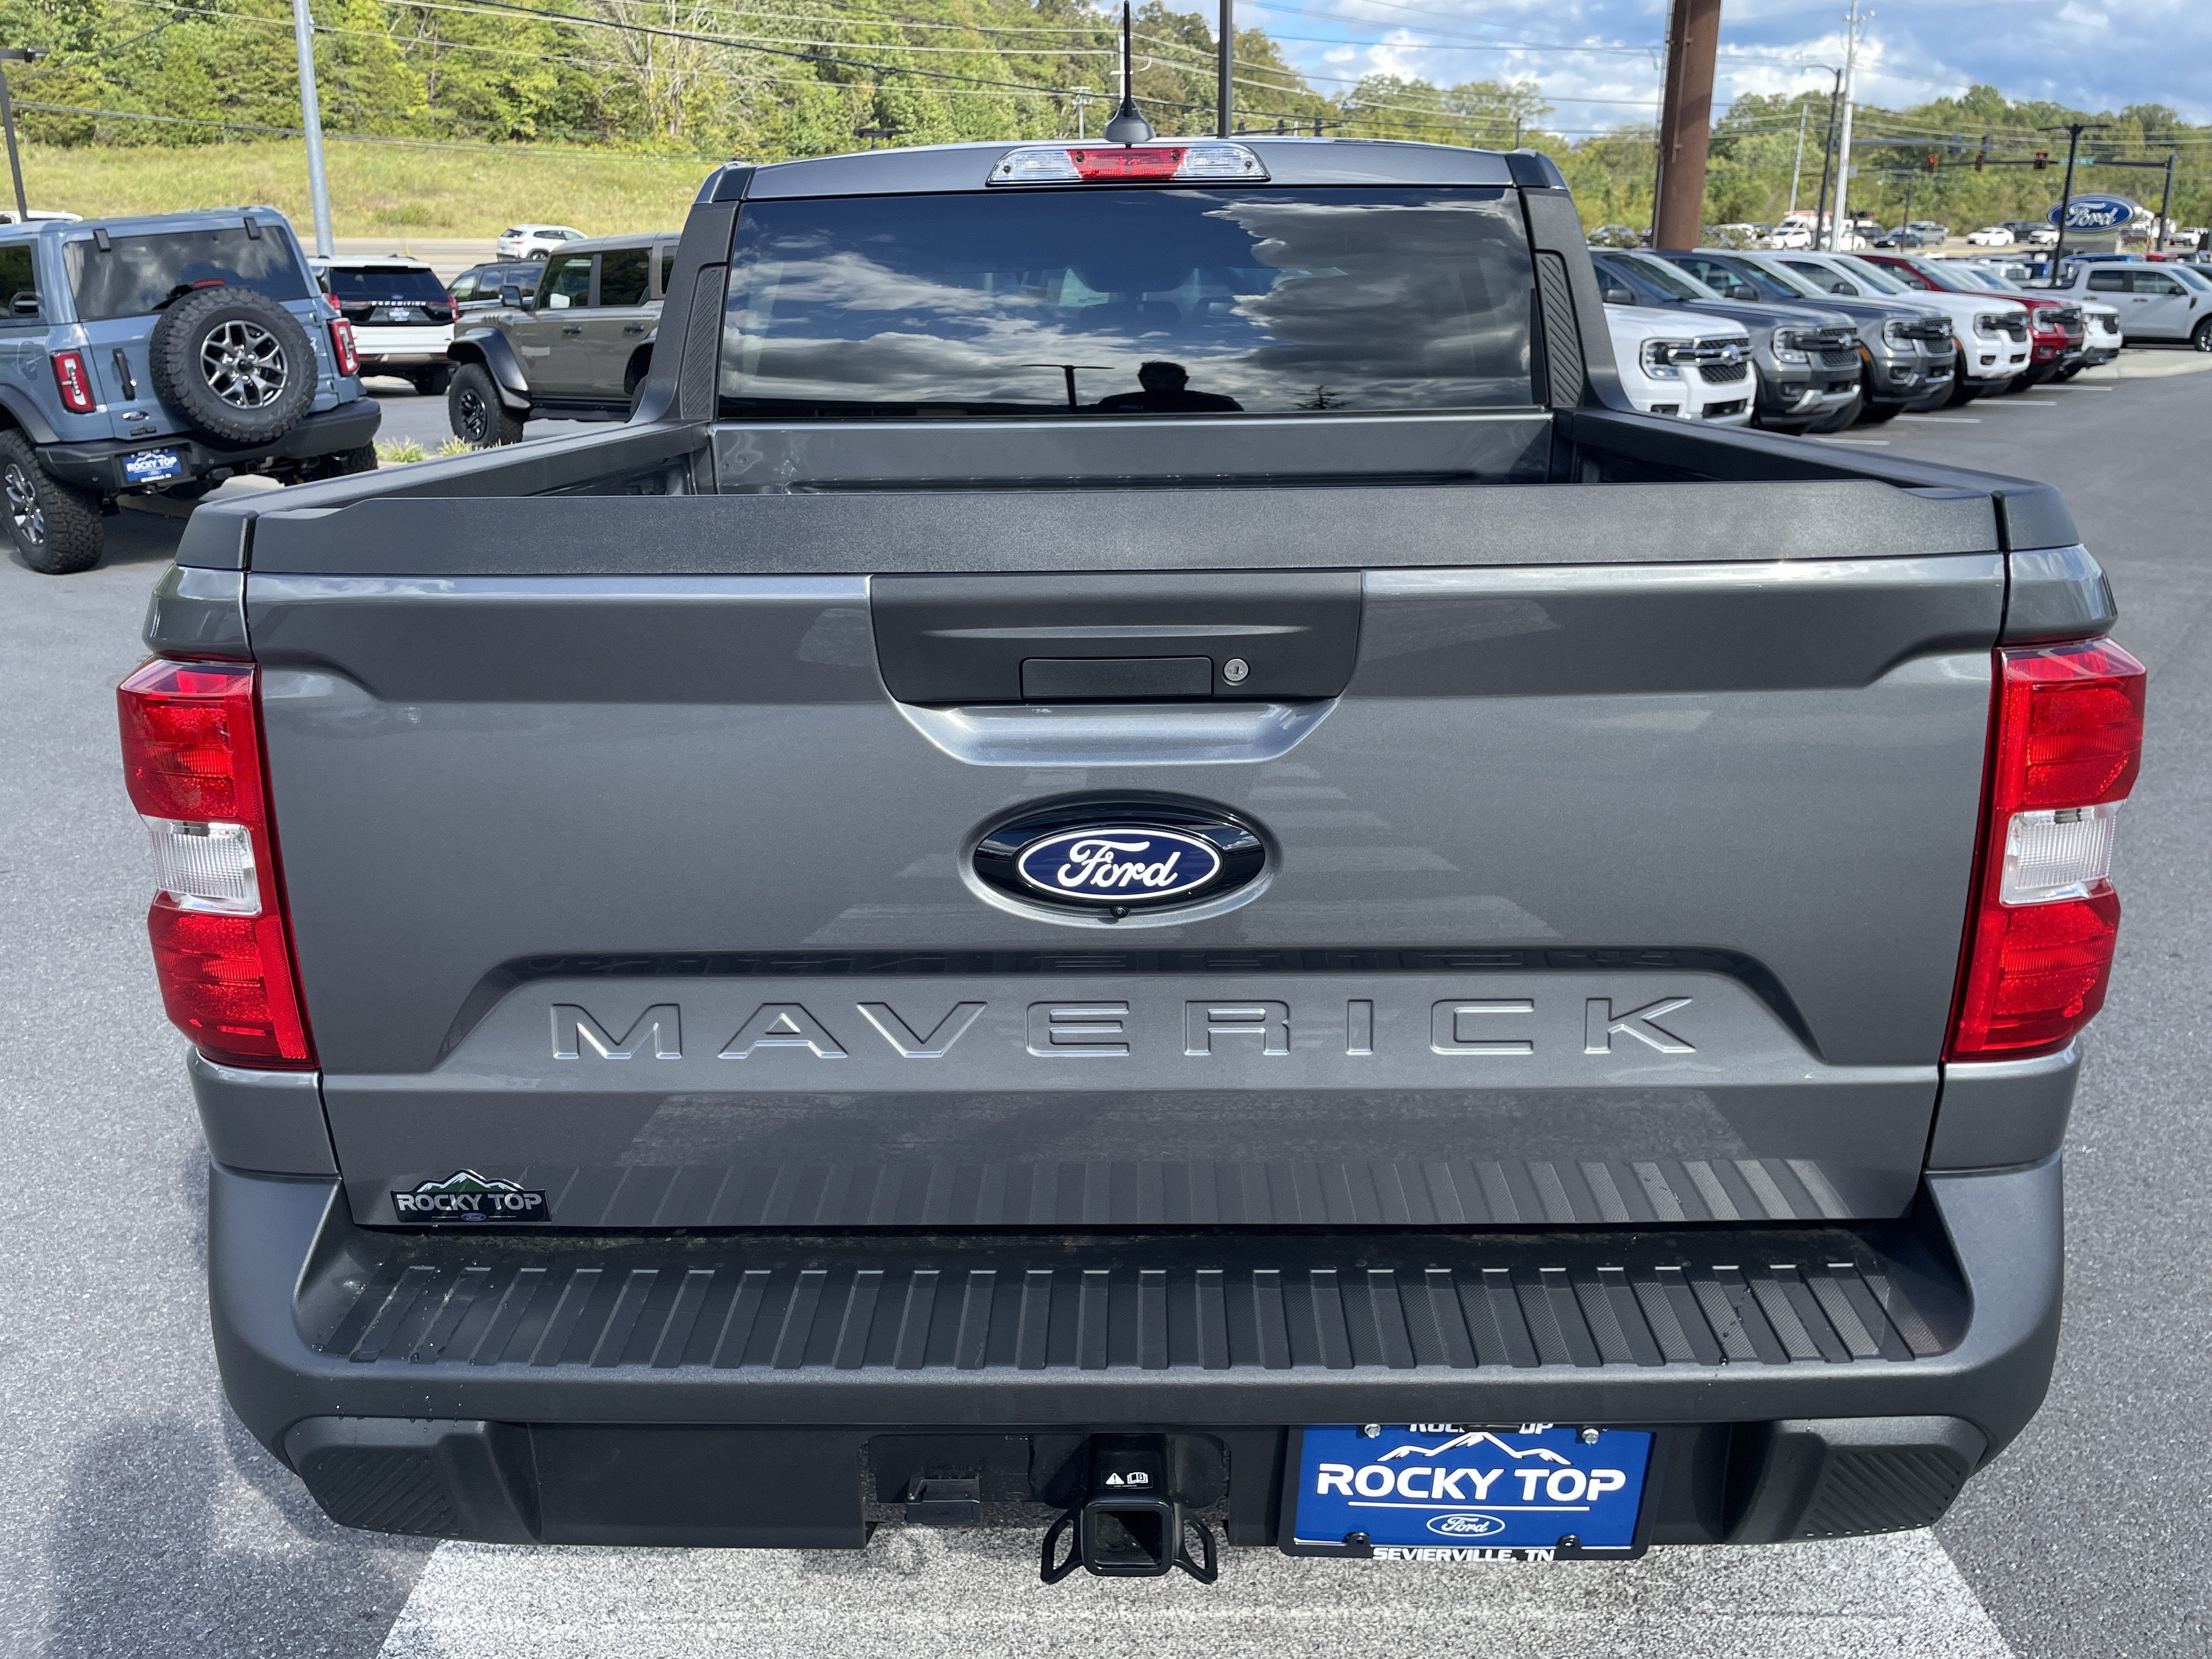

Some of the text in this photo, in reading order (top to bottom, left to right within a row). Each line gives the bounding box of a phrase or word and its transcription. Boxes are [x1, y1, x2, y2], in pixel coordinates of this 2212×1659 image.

[2064, 202, 2119, 227] Ford
[1057, 839, 1181, 888] Ford
[550, 996, 1696, 1059] MAVERICK
[396, 1193, 542, 1211] ROCKY TOP
[1317, 1463, 1627, 1502] ROCKY TOP
[1441, 1516, 1490, 1533] Ford
[1525, 1549, 1555, 1562] TN
